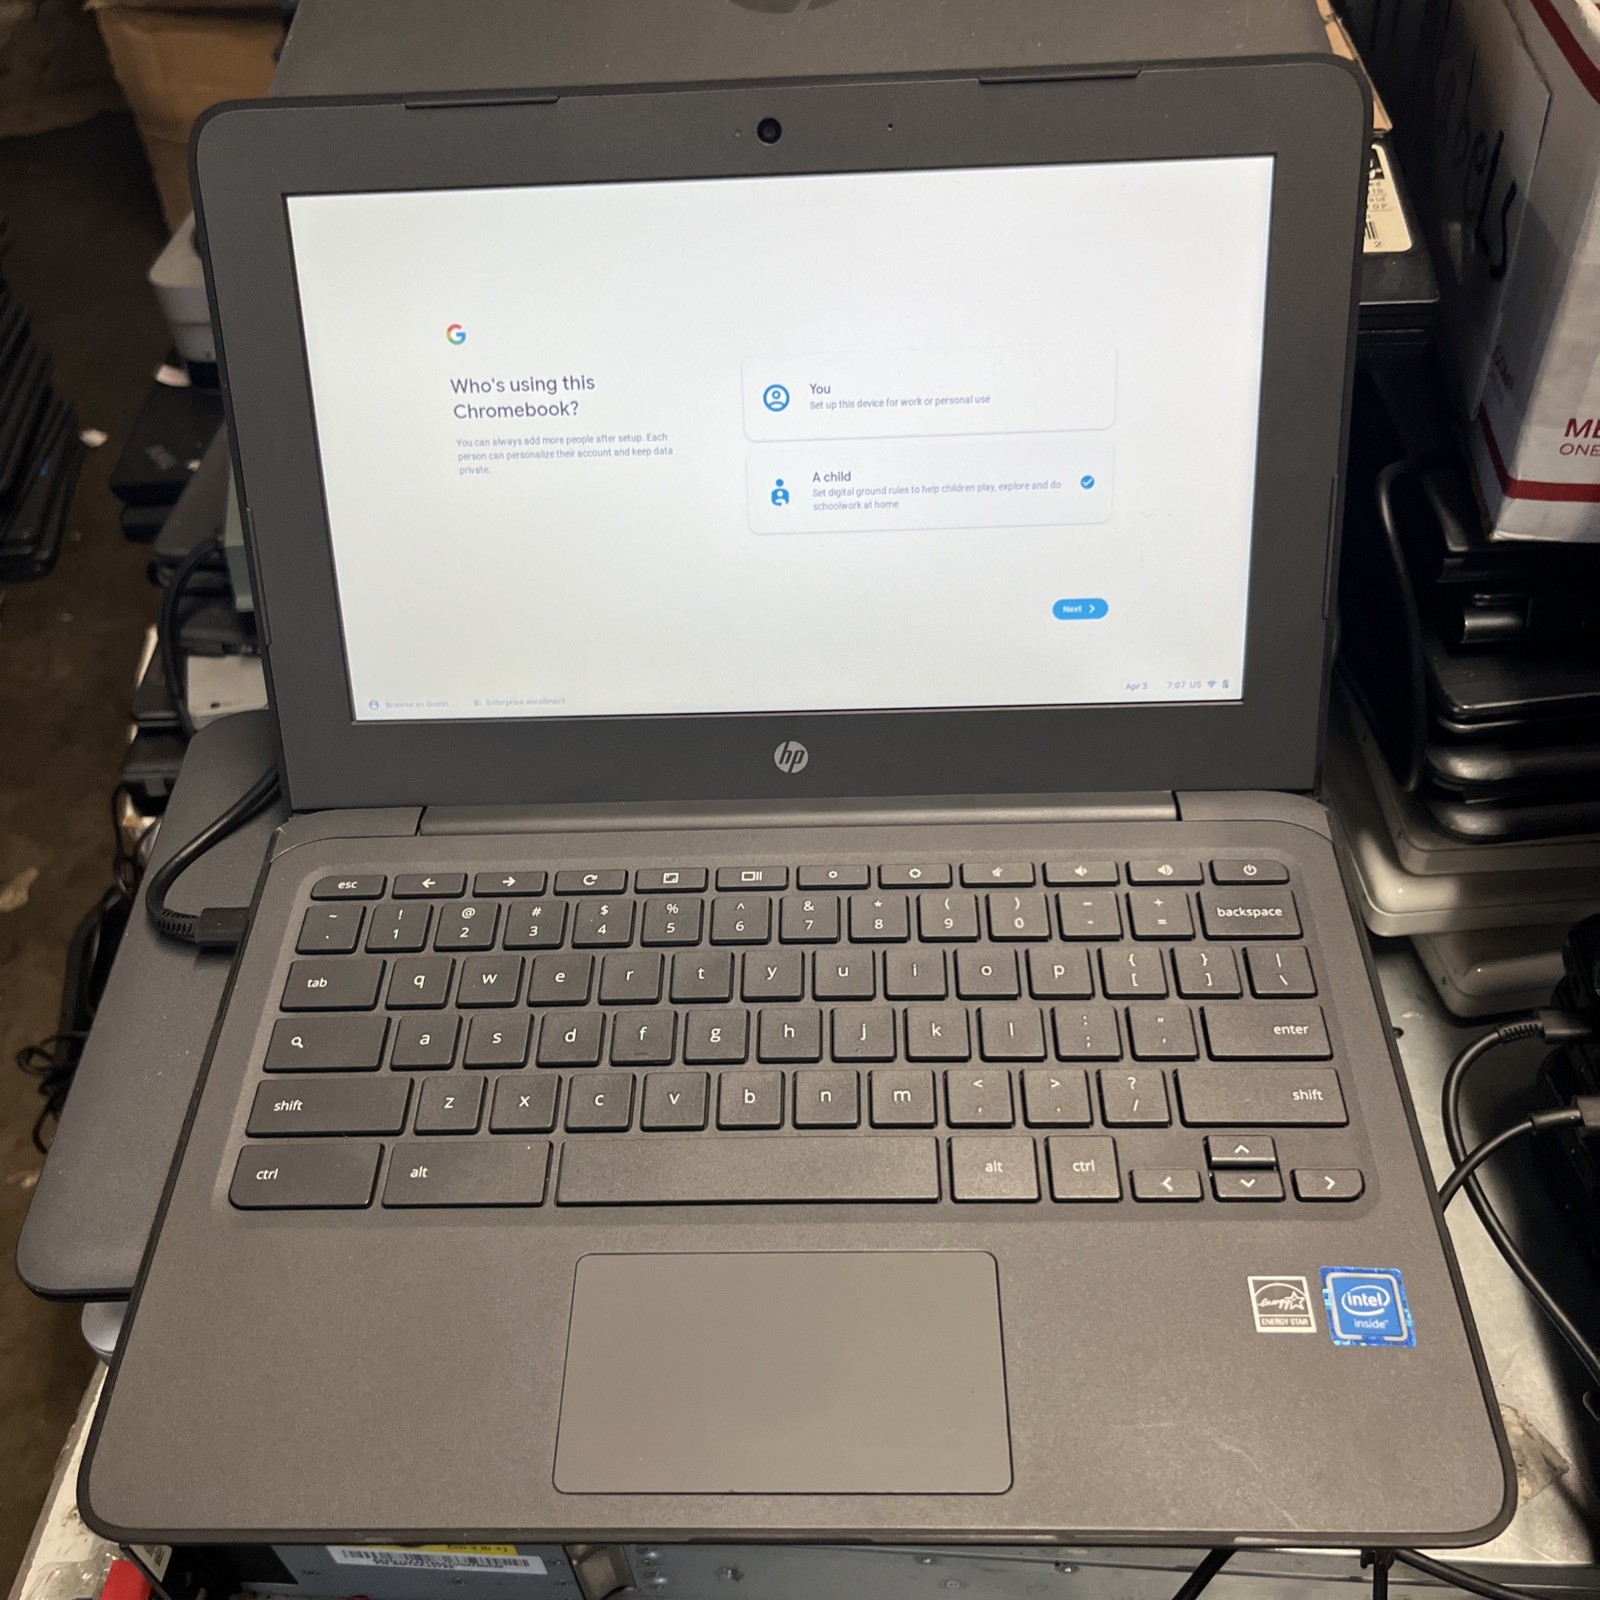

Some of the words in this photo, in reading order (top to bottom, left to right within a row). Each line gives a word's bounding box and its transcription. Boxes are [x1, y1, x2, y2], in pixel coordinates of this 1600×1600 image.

[450, 377, 506, 394] Who's
[510, 376, 557, 395] using
[563, 375, 596, 391] this
[809, 383, 831, 395] You
[809, 401, 823, 410] Set
[825, 401, 837, 411] up
[838, 399, 855, 409] this
[856, 397, 884, 408] device
[886, 397, 898, 407] for
[900, 396, 922, 406] work
[924, 397, 933, 406] or
[935, 395, 973, 407] personal
[975, 396, 991, 404] use
[453, 401, 579, 420] Chromebook?
[456, 438, 473, 447] You
[474, 438, 490, 447] can
[492, 436, 522, 447] always
[524, 436, 540, 445] add
[542, 437, 564, 445] more
[566, 435, 594, 446] people
[596, 434, 616, 443] after
[646, 433, 668, 442] Each
[458, 452, 487, 463] person
[489, 452, 504, 460] can
[506, 450, 555, 461] personalize
[556, 449, 575, 458] their
[577, 448, 612, 458] account
[614, 447, 630, 457] and
[632, 447, 652, 458] keep
[654, 446, 673, 455] data
[812, 471, 821, 483] A
[823, 471, 851, 483] child
[812, 488, 826, 498] Set
[828, 487, 855, 499] digital
[856, 486, 887, 498] ground
[888, 485, 910, 495] rules
[911, 485, 920, 495] to
[922, 484, 940, 495] help
[941, 483, 975, 493] children
[998, 481, 1030, 492] explore
[1031, 480, 1048, 490] and
[1050, 480, 1062, 490] do
[813, 500, 862, 511] schoolwork
[863, 501, 873, 509] at
[874, 499, 899, 509] home
[1062, 605, 1082, 614] Next
[1125, 682, 1140, 692] Apr
[1141, 682, 1148, 690] 3
[1166, 681, 1186, 690] 7:07
[1189, 680, 1202, 690] US
[777, 740, 807, 774] hp
[337, 881, 358, 890] esc
[666, 903, 679, 914] %
[803, 900, 815, 912] &
[1153, 898, 1164, 907] +
[461, 907, 476, 919] @
[531, 906, 542, 917] #
[600, 904, 609, 916] $
[1216, 906, 1283, 919] backspace
[666, 922, 676, 934] 5
[735, 920, 745, 932] 6
[805, 919, 814, 931] 7
[874, 918, 884, 930] 8
[944, 917, 954, 929] 9
[1014, 917, 1025, 929] 0
[393, 928, 399, 940] 1
[459, 927, 470, 938] 2
[528, 925, 538, 937] 3
[597, 924, 607, 935] 4
[1128, 953, 1136, 967] {
[1200, 953, 1208, 967] }
[626, 970, 635, 981] r
[698, 967, 705, 980] t
[766, 966, 778, 981] y
[838, 966, 849, 977] u
[913, 963, 917, 977] i
[981, 965, 993, 976] o
[1053, 964, 1065, 979] p
[307, 977, 328, 988] tab
[413, 975, 426, 989] q
[482, 973, 498, 984] w
[555, 972, 566, 983] e
[1131, 972, 1139, 987] [
[1204, 972, 1213, 987] ]
[564, 1028, 577, 1043] d
[639, 1026, 648, 1041] f
[709, 1028, 722, 1043] g
[784, 1024, 795, 1038] h
[860, 1023, 867, 1041] j
[931, 1022, 942, 1037] k
[1273, 1025, 1309, 1035] enter
[419, 1034, 431, 1046] a
[492, 1032, 502, 1044] s
[973, 1079, 983, 1088] <
[1050, 1078, 1061, 1088] >
[1127, 1076, 1137, 1090] ?
[594, 1094, 605, 1106] c
[669, 1093, 681, 1105] v
[744, 1088, 756, 1104] b
[820, 1091, 832, 1103] n
[893, 1090, 911, 1102] m
[1292, 1088, 1324, 1101] shift
[273, 1099, 304, 1112] shift
[444, 1097, 455, 1109] z
[518, 1095, 531, 1108] x
[409, 1165, 428, 1178] alt
[984, 1160, 1004, 1173] alt
[1072, 1159, 1096, 1172] ctrl
[256, 1168, 279, 1180] ctrl
[1347, 1291, 1384, 1307] intel
[1261, 1318, 1289, 1326] ENERGY
[1289, 1318, 1310, 1326] STAR
[1353, 1318, 1387, 1329] inside
